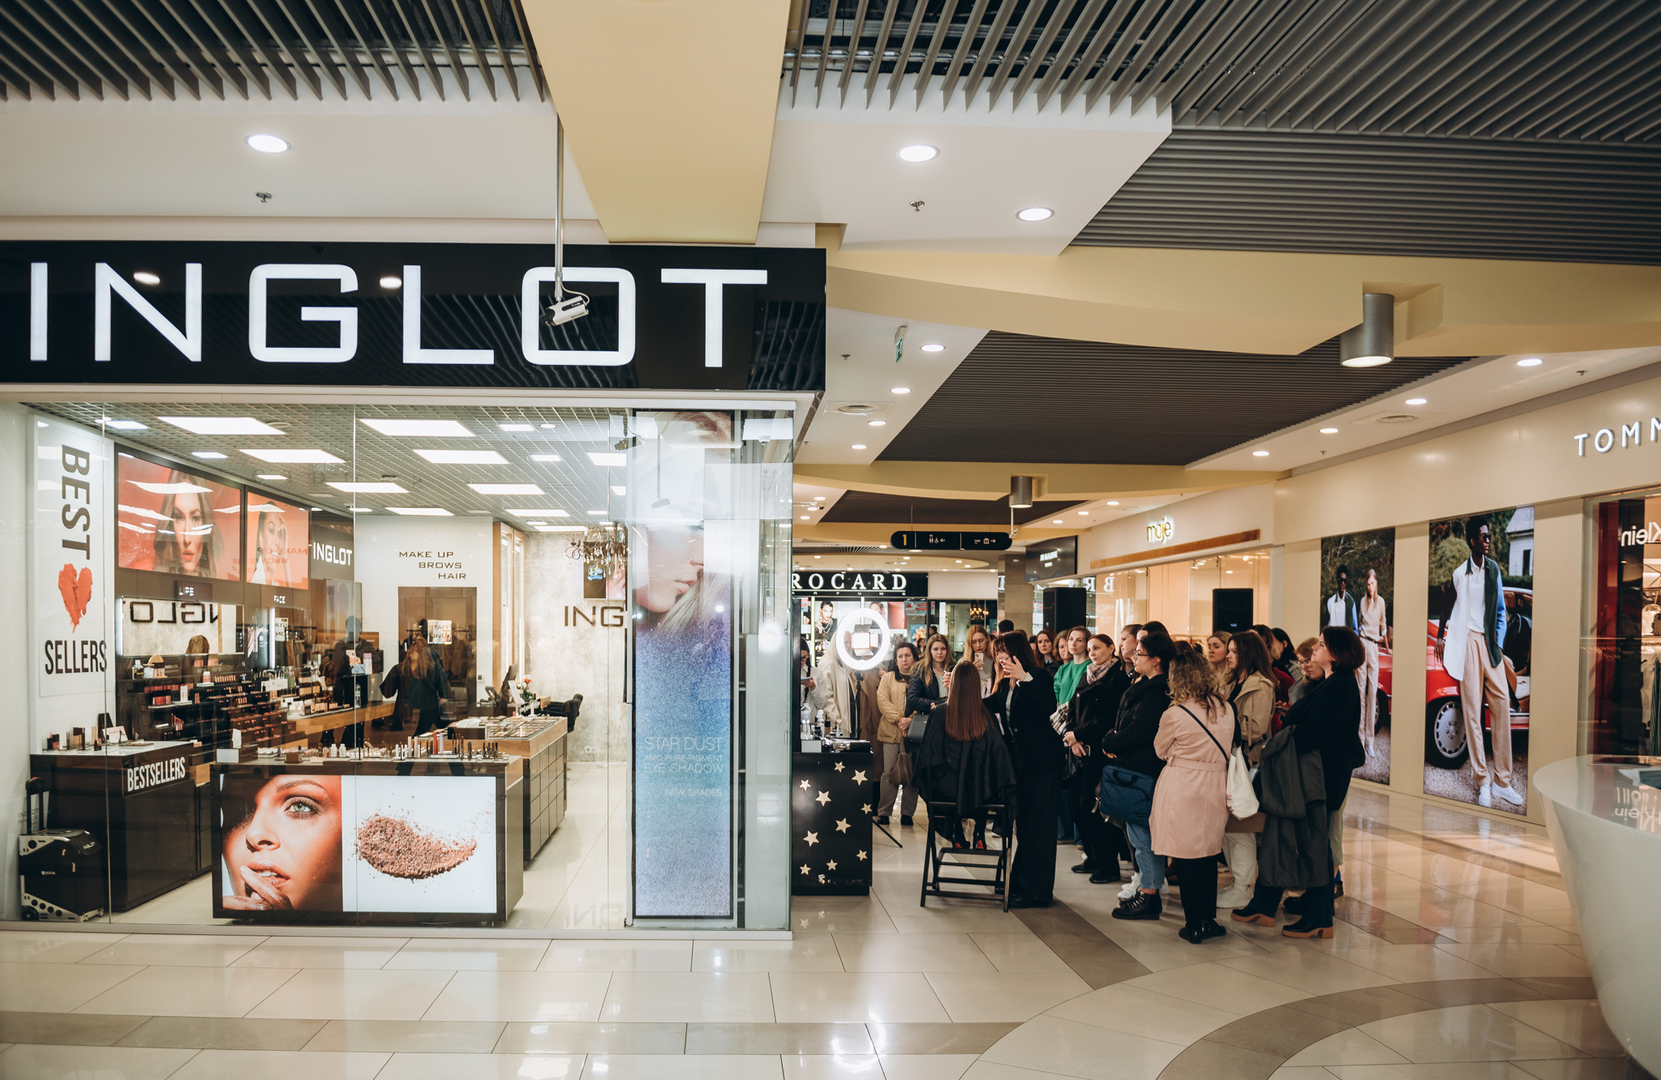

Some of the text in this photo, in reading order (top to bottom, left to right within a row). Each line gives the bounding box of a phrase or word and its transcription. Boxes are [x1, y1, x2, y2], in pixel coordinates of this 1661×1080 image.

[30, 262, 768, 368] INGLOT
[62, 444, 90, 560] BEST
[903, 534, 907, 546] 1
[1146, 517, 1172, 542] maje
[313, 541, 353, 566] INGLOT
[564, 605, 624, 627] ING
[45, 640, 107, 675] SELLERS
[644, 736, 724, 751] STAR DUST
[644, 762, 724, 773] EYE SHADOW
[688, 754, 723, 762] PIGMENT
[127, 756, 186, 792] BESTSELLERS
[664, 788, 723, 796] NEW SHADES
